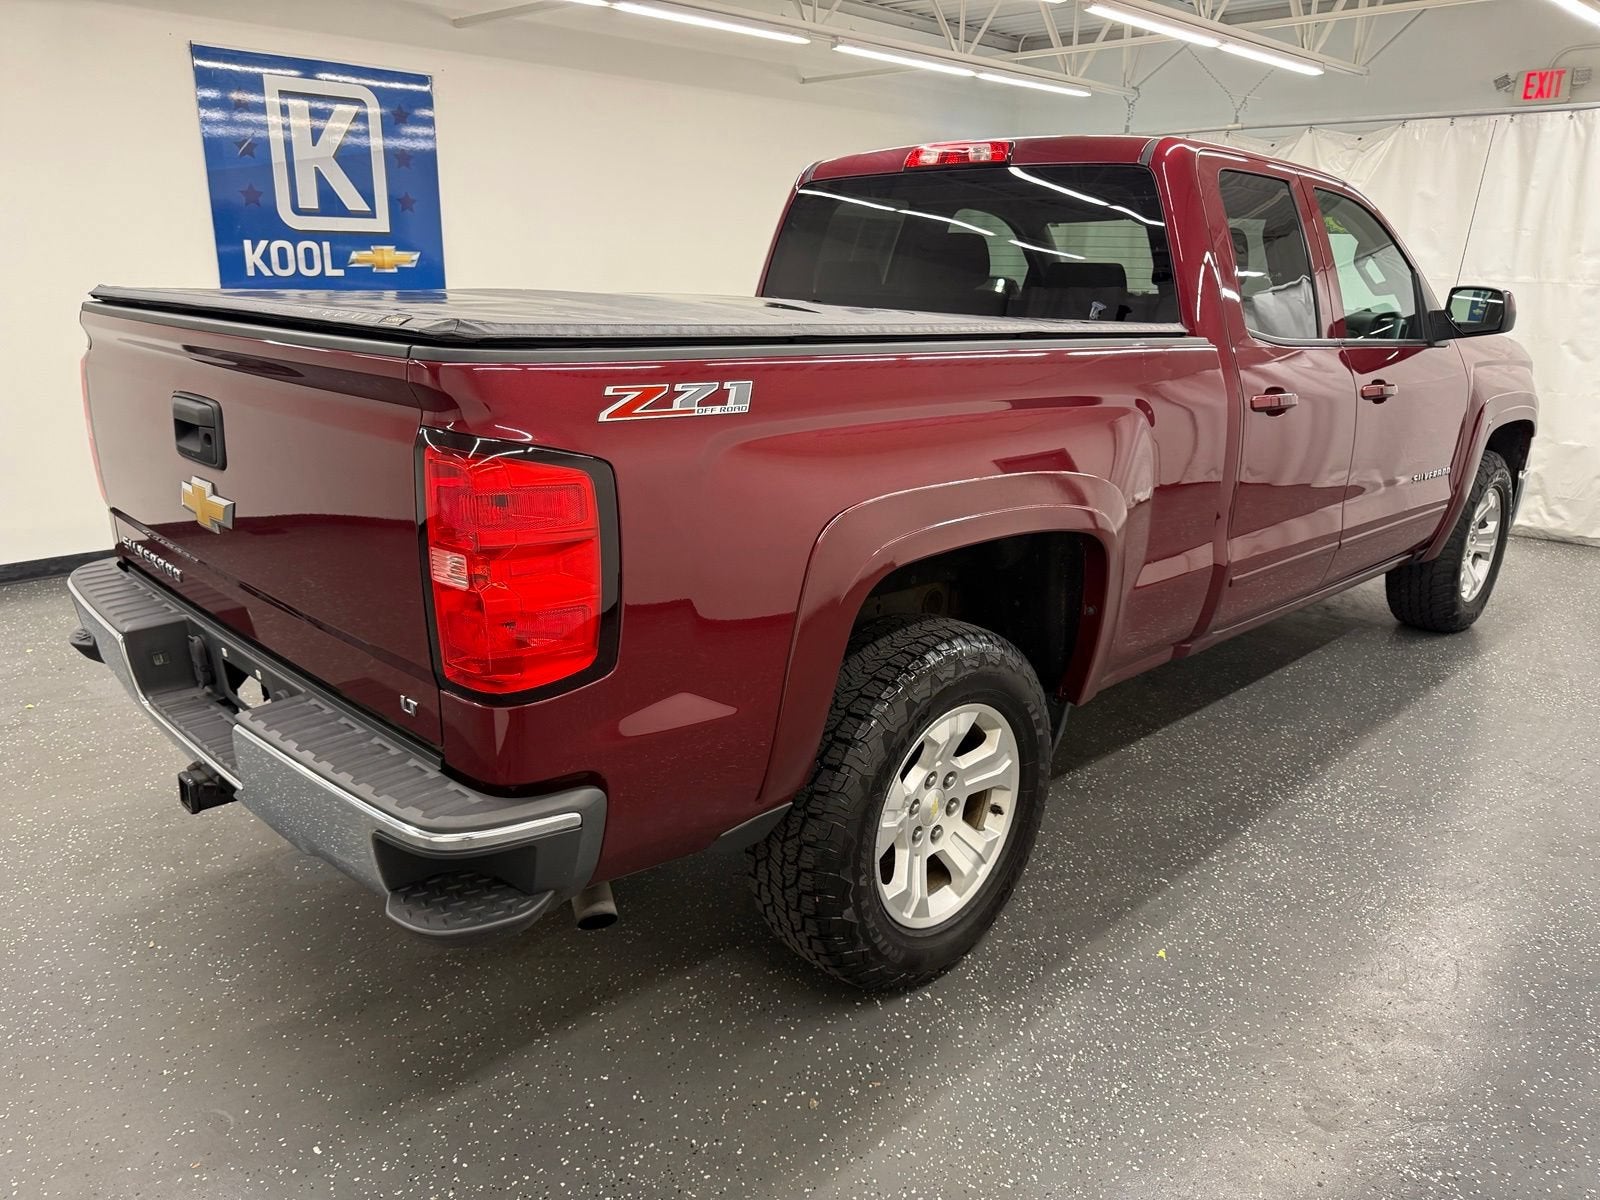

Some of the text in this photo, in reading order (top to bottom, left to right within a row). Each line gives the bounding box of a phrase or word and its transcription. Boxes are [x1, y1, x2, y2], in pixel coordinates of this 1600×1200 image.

[1522, 69, 1567, 100] EXIT
[242, 239, 345, 277] KOOL
[597, 380, 753, 422] Z71
[696, 405, 749, 415] OFF ROAD
[1412, 466, 1451, 481] SILVERADO
[400, 694, 419, 718] LT
